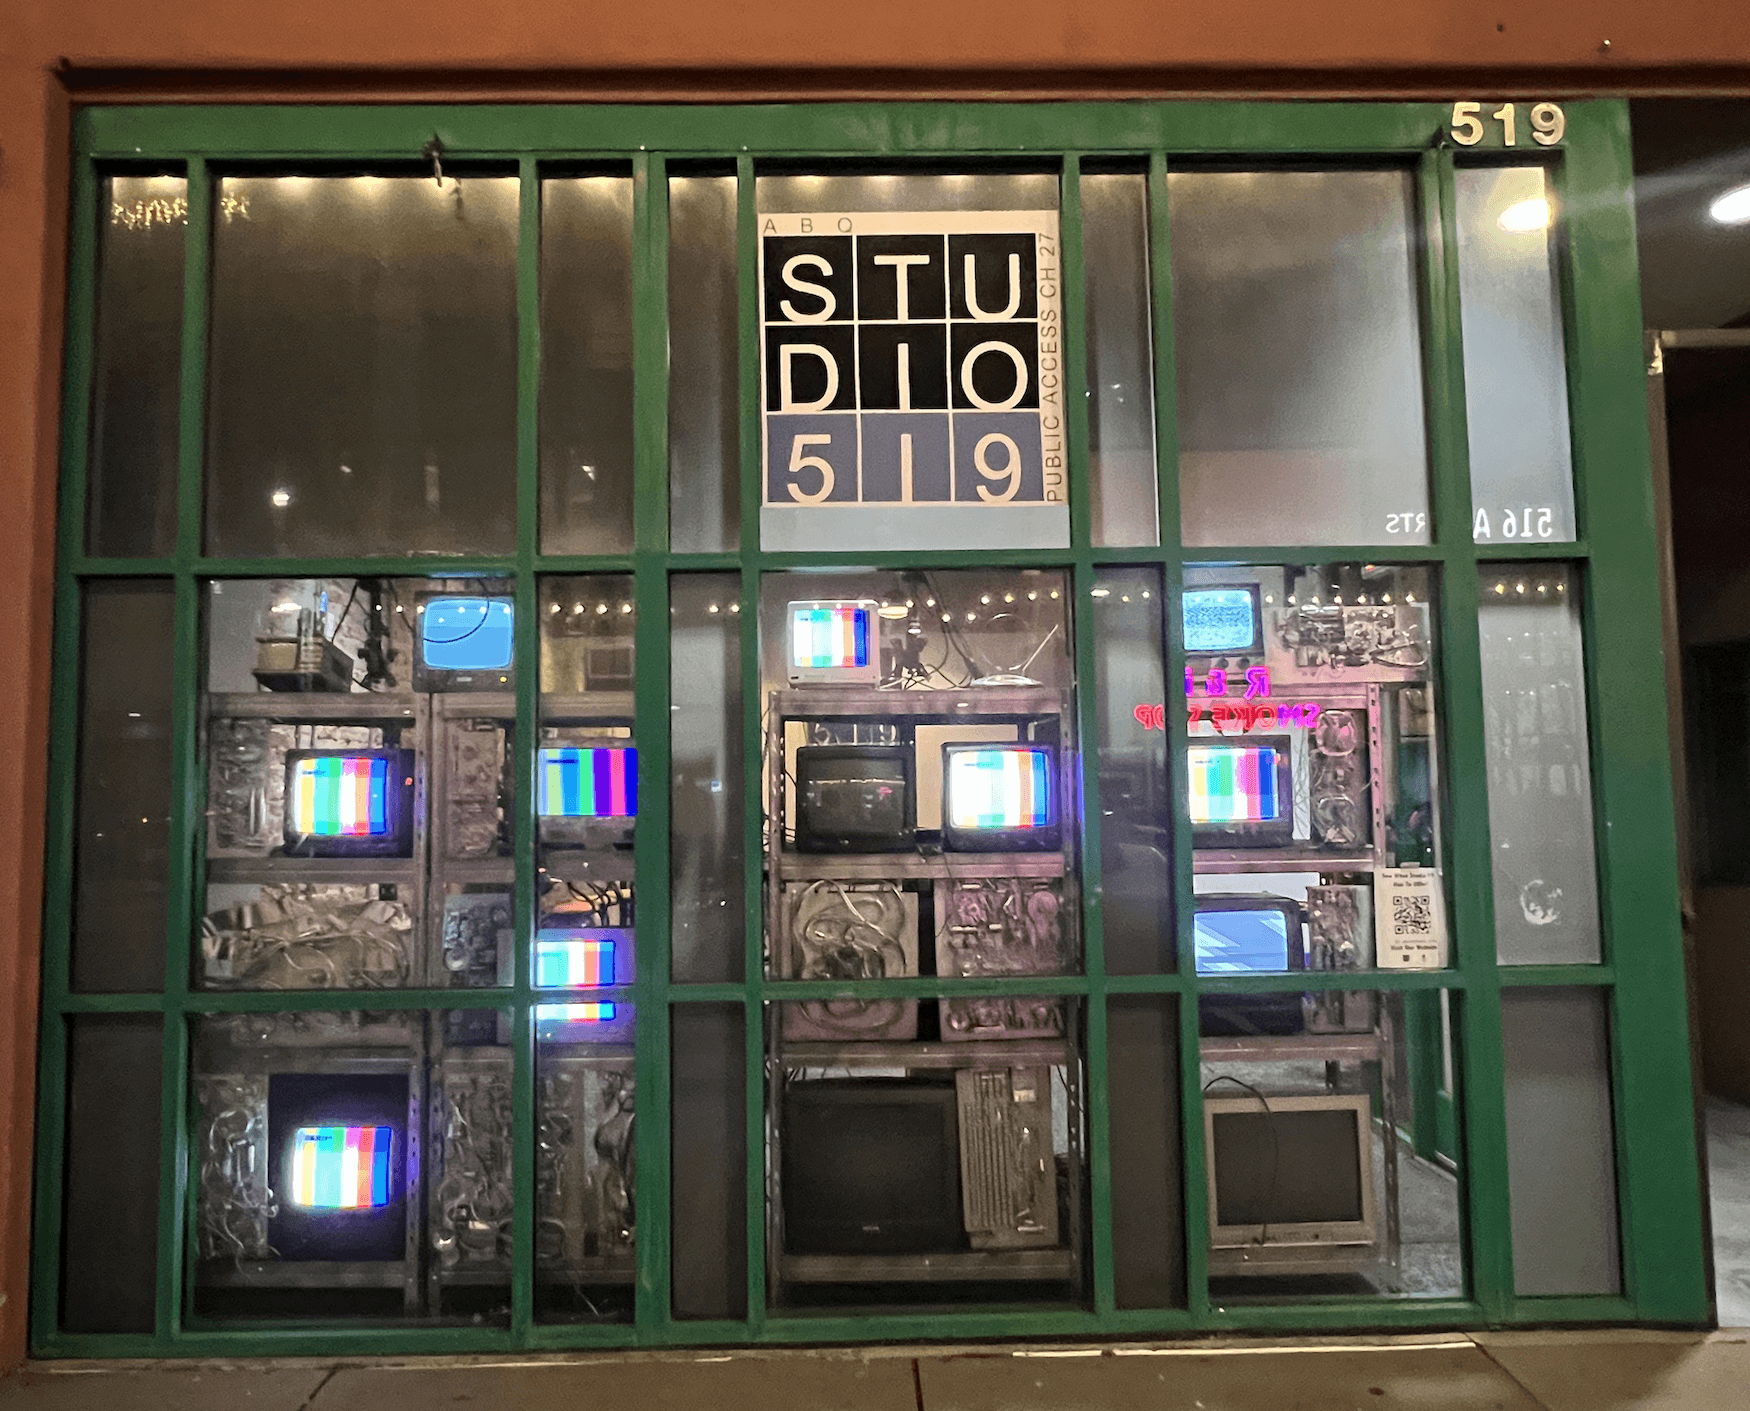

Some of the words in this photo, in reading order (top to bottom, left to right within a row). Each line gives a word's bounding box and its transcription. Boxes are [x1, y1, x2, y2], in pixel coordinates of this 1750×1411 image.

[1451, 102, 1565, 146] 519
[1038, 232, 1055, 256] 27
[1039, 267, 1057, 298] CH
[1040, 309, 1058, 405] ACCESS
[1043, 415, 1062, 502] PUBLIC
